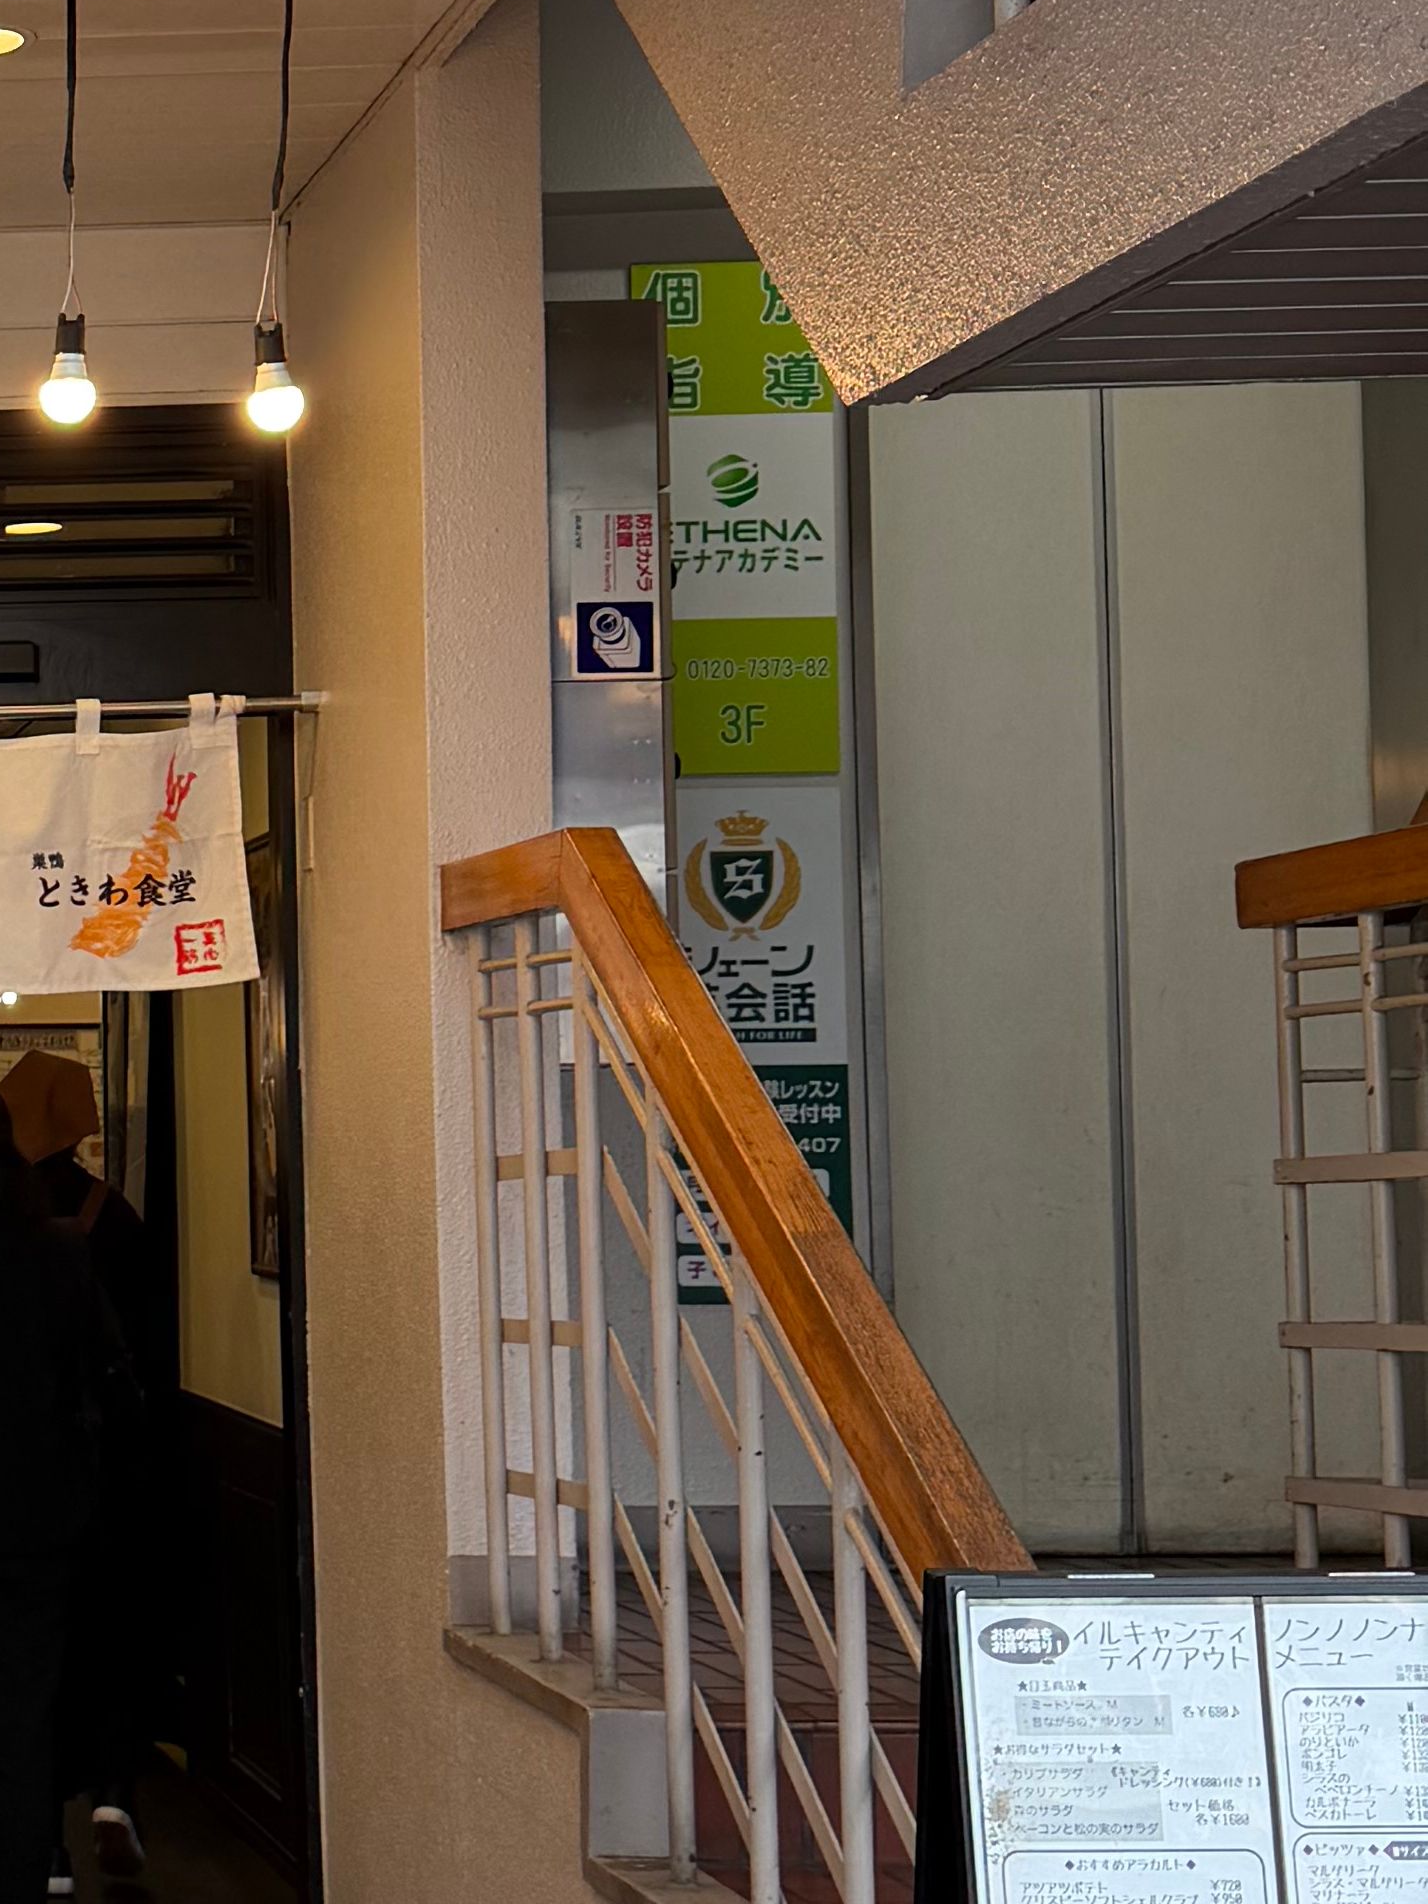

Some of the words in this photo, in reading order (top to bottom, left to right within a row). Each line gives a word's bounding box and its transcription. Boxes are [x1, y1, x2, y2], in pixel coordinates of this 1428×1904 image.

[670, 518, 822, 544] THENA
[635, 514, 653, 591] 防犯カメラ
[672, 548, 824, 574] テナアカデミー
[687, 658, 830, 680] 0120-7373-82
[720, 704, 766, 745] 3F
[39, 869, 197, 908] ときわ食堂
[710, 982, 816, 1025] 会話
[1073, 1620, 1247, 1645] イルキャンティ
[1099, 1646, 1250, 1671] テイクアウト
[1275, 1644, 1374, 1670] メニュー
